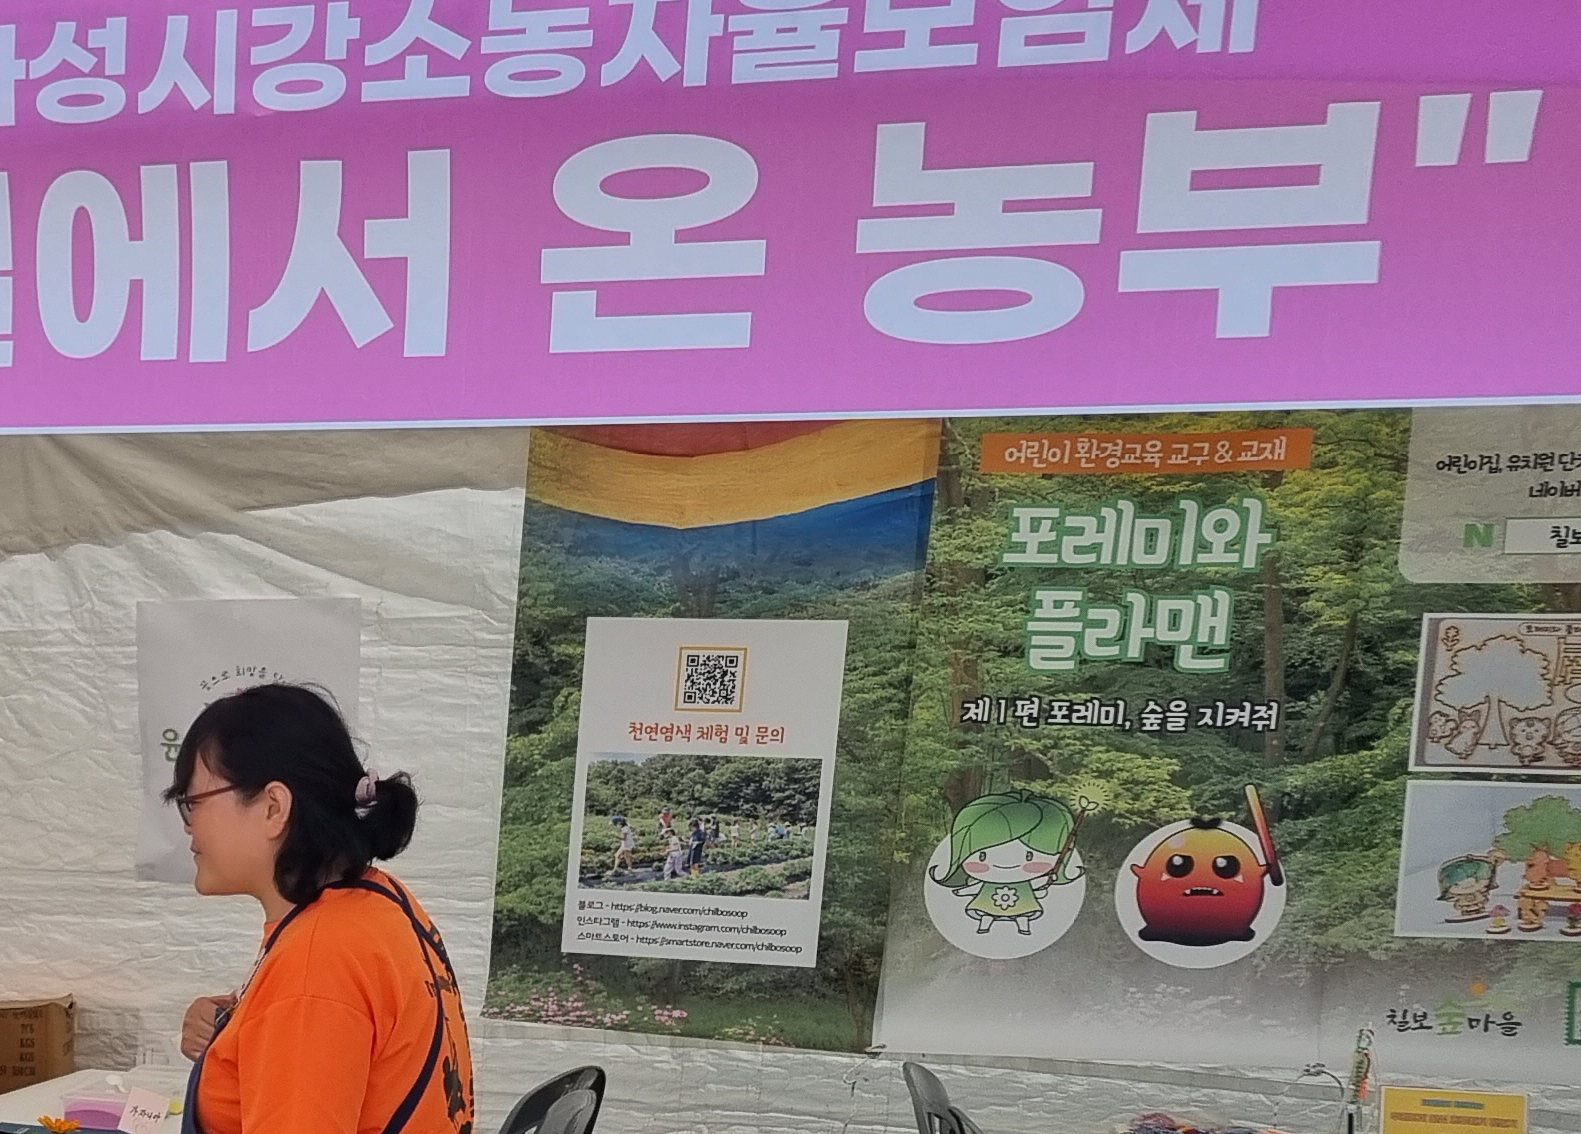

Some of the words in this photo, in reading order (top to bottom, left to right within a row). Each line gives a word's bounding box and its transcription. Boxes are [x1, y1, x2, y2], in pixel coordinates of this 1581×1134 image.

[540, 132, 767, 354] 온
[1004, 439, 1070, 468] 어린이
[1074, 437, 1164, 469] 환경교육
[1166, 441, 1210, 468] 교구
[1214, 441, 1230, 461] &
[1235, 435, 1287, 463] 교재
[1505, 451, 1555, 473] 유치원
[1003, 498, 1273, 570] 포레미와
[1462, 522, 1495, 549] N
[1026, 589, 1232, 673] 플라맨
[1047, 700, 1131, 730] 포레미,
[1139, 701, 1189, 732] 숲을
[1196, 701, 1280, 732] 지켜줘
[627, 720, 693, 743] 천연염색
[696, 723, 729, 744] 체험
[734, 725, 750, 745] 및
[754, 725, 785, 745] 문의
[577, 900, 604, 911] 블로그
[576, 916, 620, 929] 인스타그램
[576, 932, 629, 943] 스마트스토어
